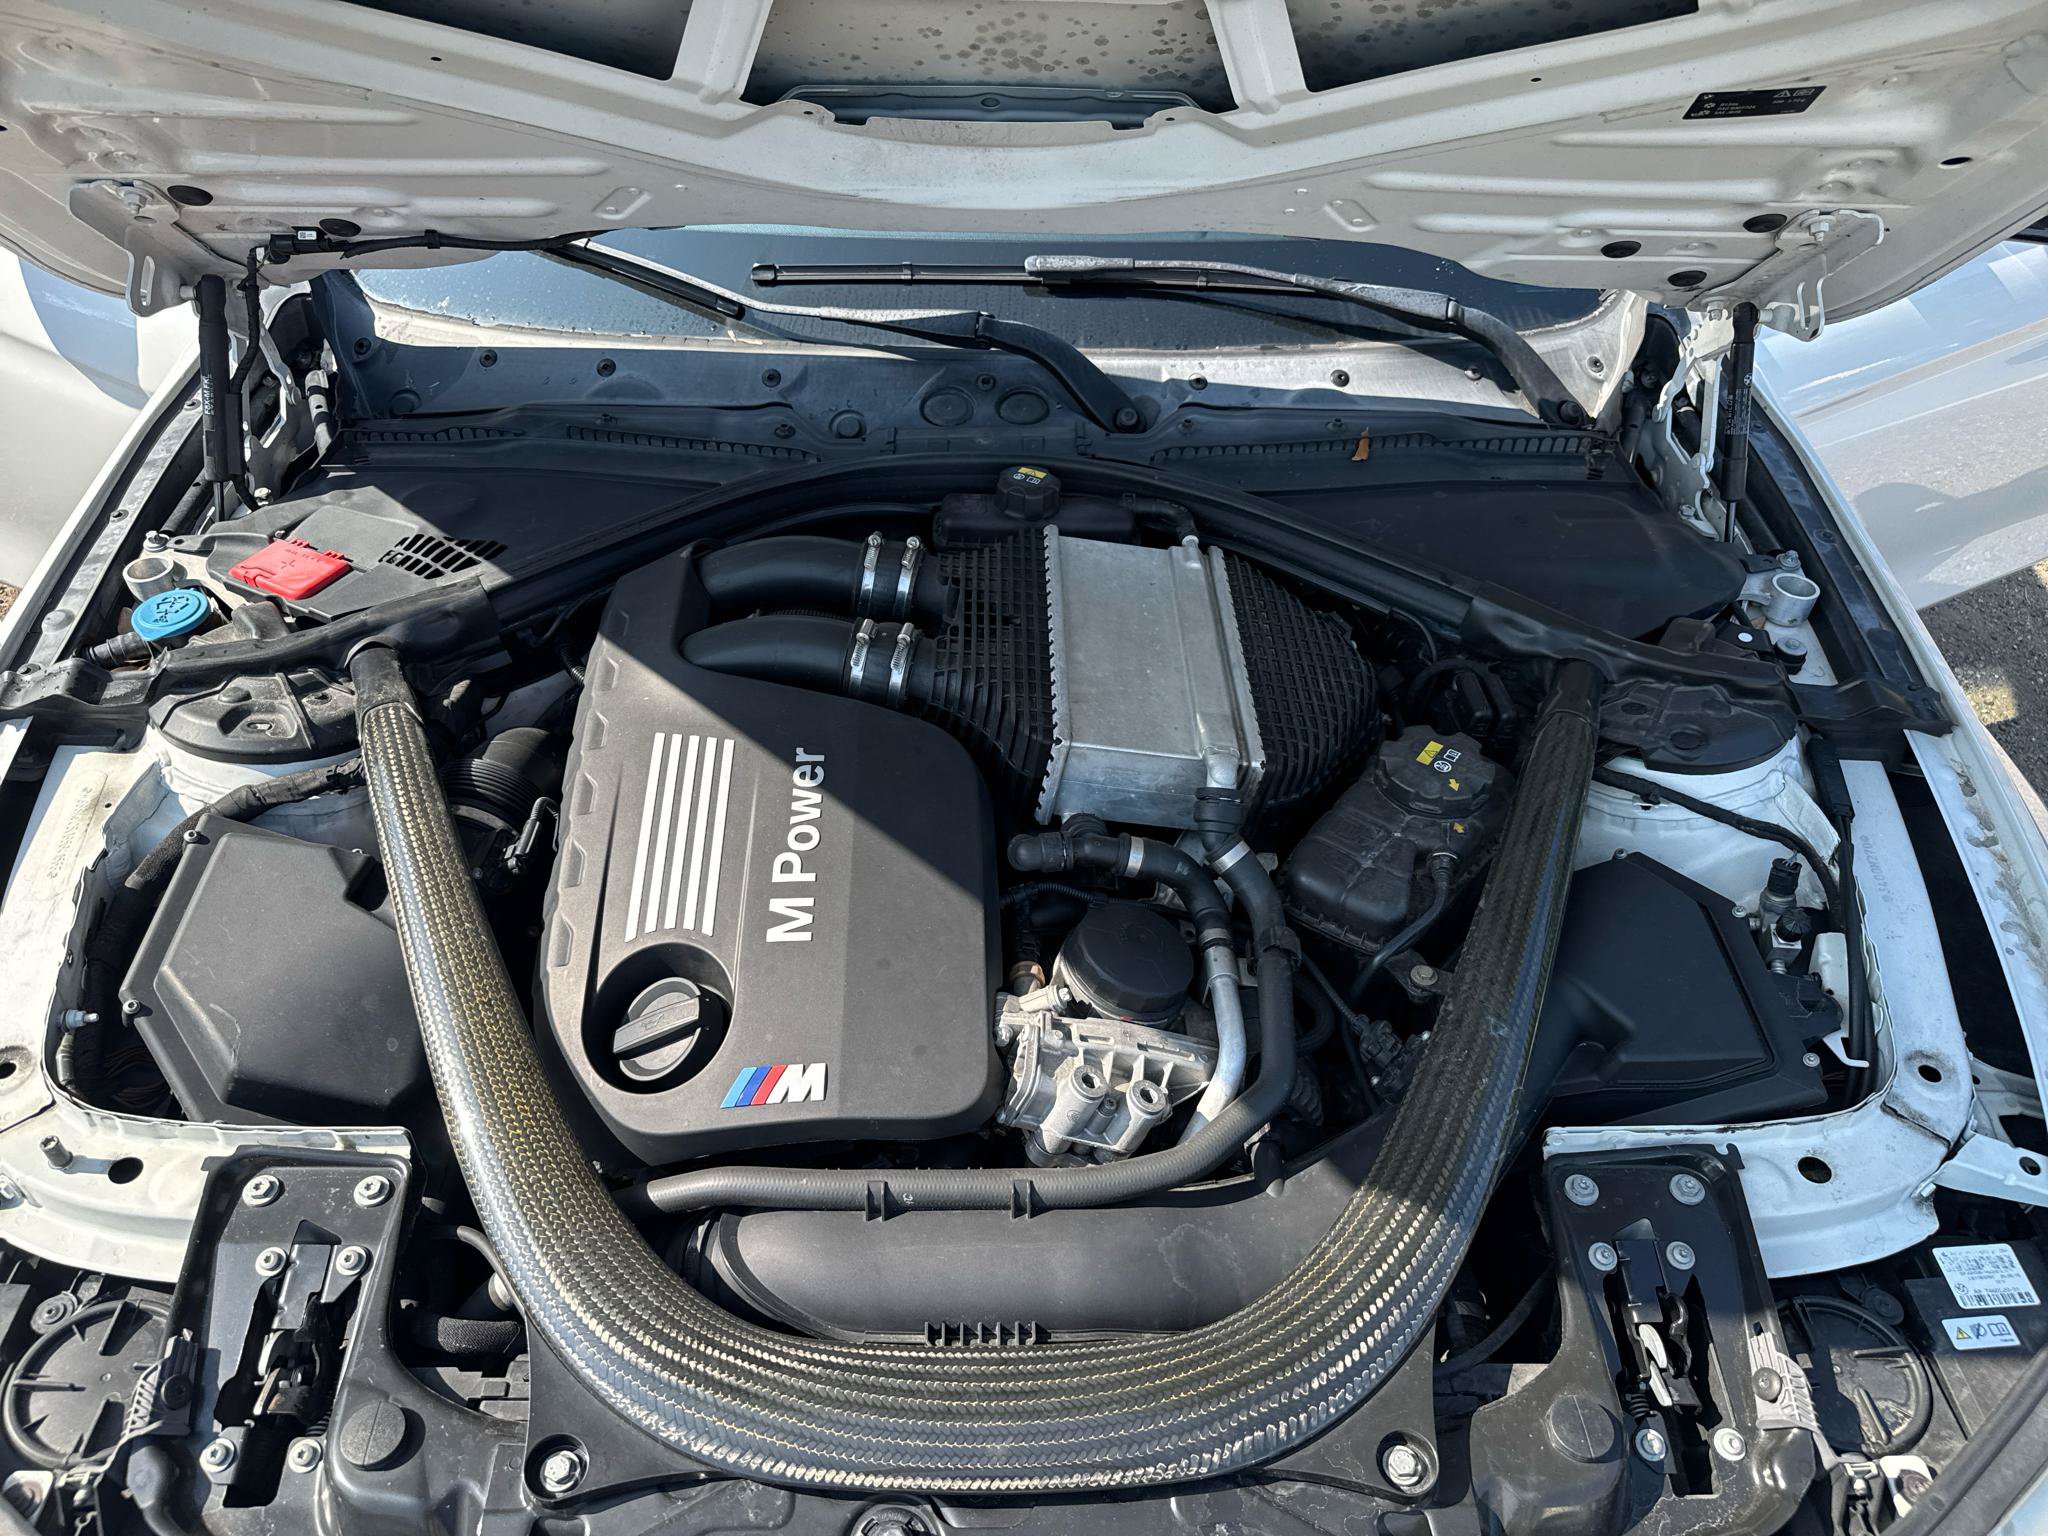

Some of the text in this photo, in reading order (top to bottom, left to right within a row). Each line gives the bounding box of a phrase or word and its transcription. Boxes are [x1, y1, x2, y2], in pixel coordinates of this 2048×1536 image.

[766, 747, 825, 943] M Power
[764, 1062, 828, 1105] M
